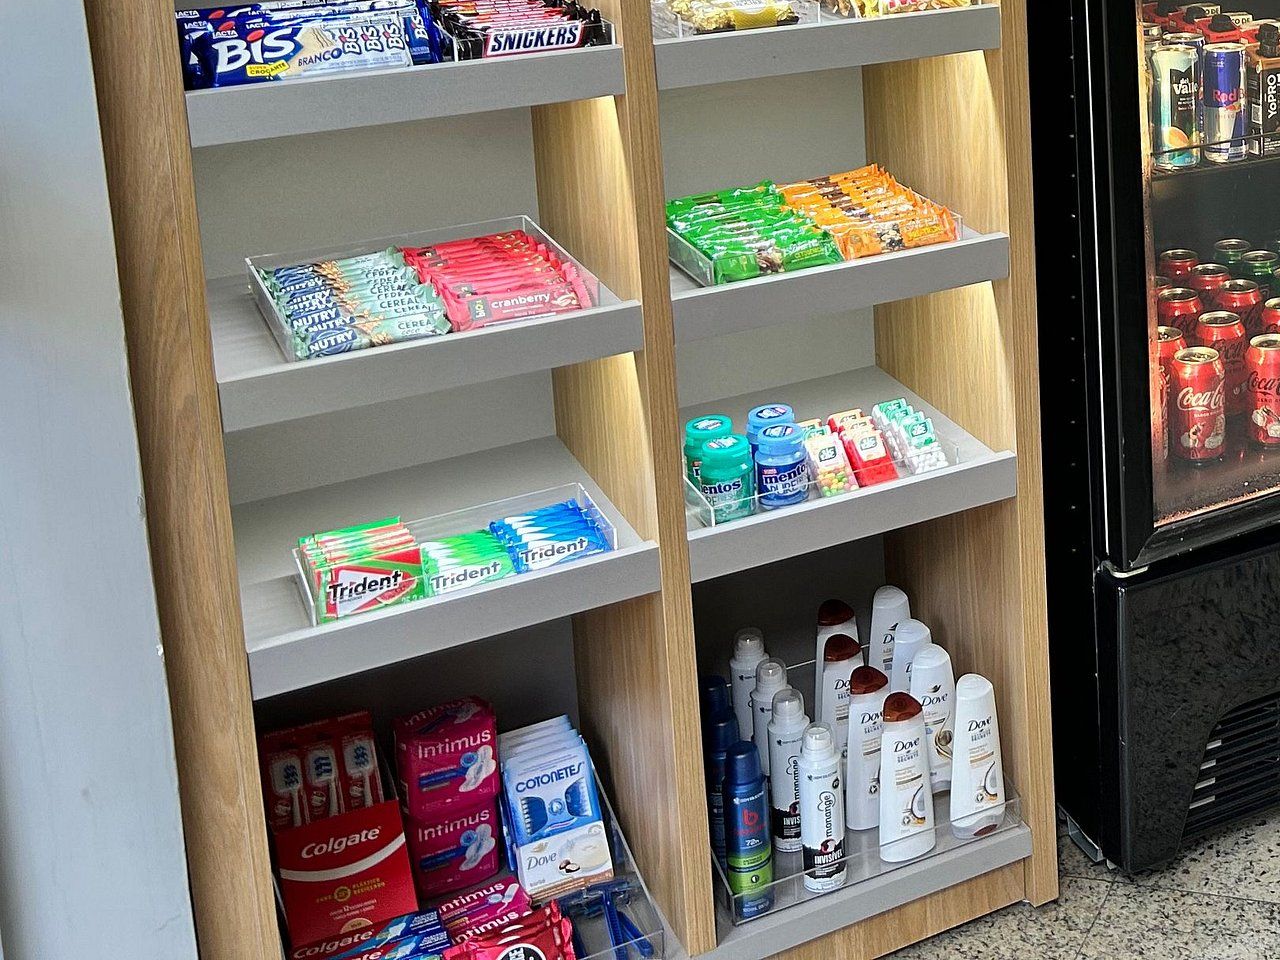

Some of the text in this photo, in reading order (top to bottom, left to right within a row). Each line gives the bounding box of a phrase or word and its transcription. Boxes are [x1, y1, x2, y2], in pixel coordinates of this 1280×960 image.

[490, 25, 579, 53] SNICKERS
[298, 47, 343, 67] BRANCO
[491, 293, 550, 309] cranberry
[292, 308, 337, 329] NUTRY
[397, 319, 432, 330] CEREA
[308, 330, 355, 354] NUTRY
[1177, 386, 1226, 411] Coca-Co
[763, 463, 806, 485] mento
[702, 479, 741, 495] entos
[521, 537, 588, 565] Trident
[328, 570, 403, 603] Trident
[430, 561, 501, 591] Trident
[921, 693, 948, 707] Dove
[967, 715, 992, 732] Dove
[418, 728, 492, 759] Intimus
[893, 737, 920, 753] Dove
[515, 762, 585, 793] COTONETES
[418, 810, 491, 842] Intimus
[783, 816, 801, 826] INVIS
[301, 826, 382, 859] Colgate
[526, 851, 557, 871] Dove
[293, 929, 375, 960] Colgate
